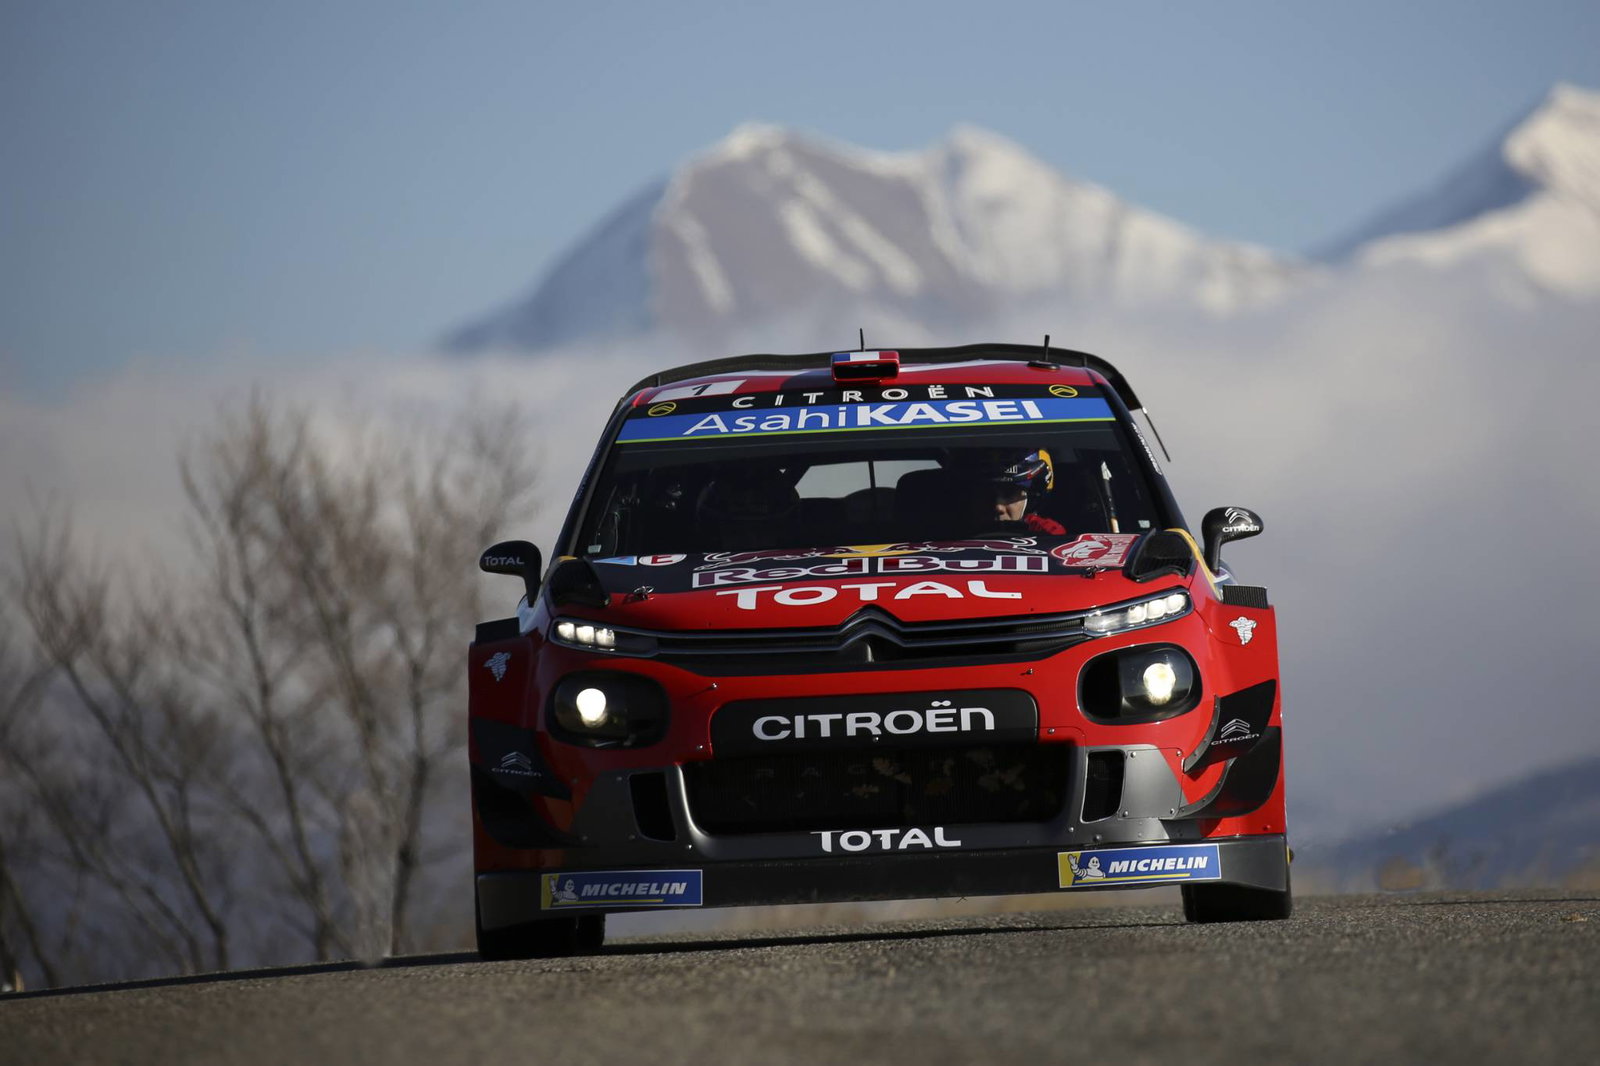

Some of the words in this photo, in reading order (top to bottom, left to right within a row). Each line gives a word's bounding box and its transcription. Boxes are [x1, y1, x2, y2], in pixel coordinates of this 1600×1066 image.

[692, 384, 712, 396] 1
[732, 385, 995, 409] CITROËN
[484, 556, 525, 566] TOTAL
[692, 558, 870, 588] Red
[877, 554, 1049, 574] Bull
[715, 580, 1023, 611] TOTAL
[752, 700, 995, 741] CITROËN
[809, 827, 962, 853] TOTAL
[1108, 856, 1209, 874] MICHELIN
[580, 882, 688, 897] MICHELIN
